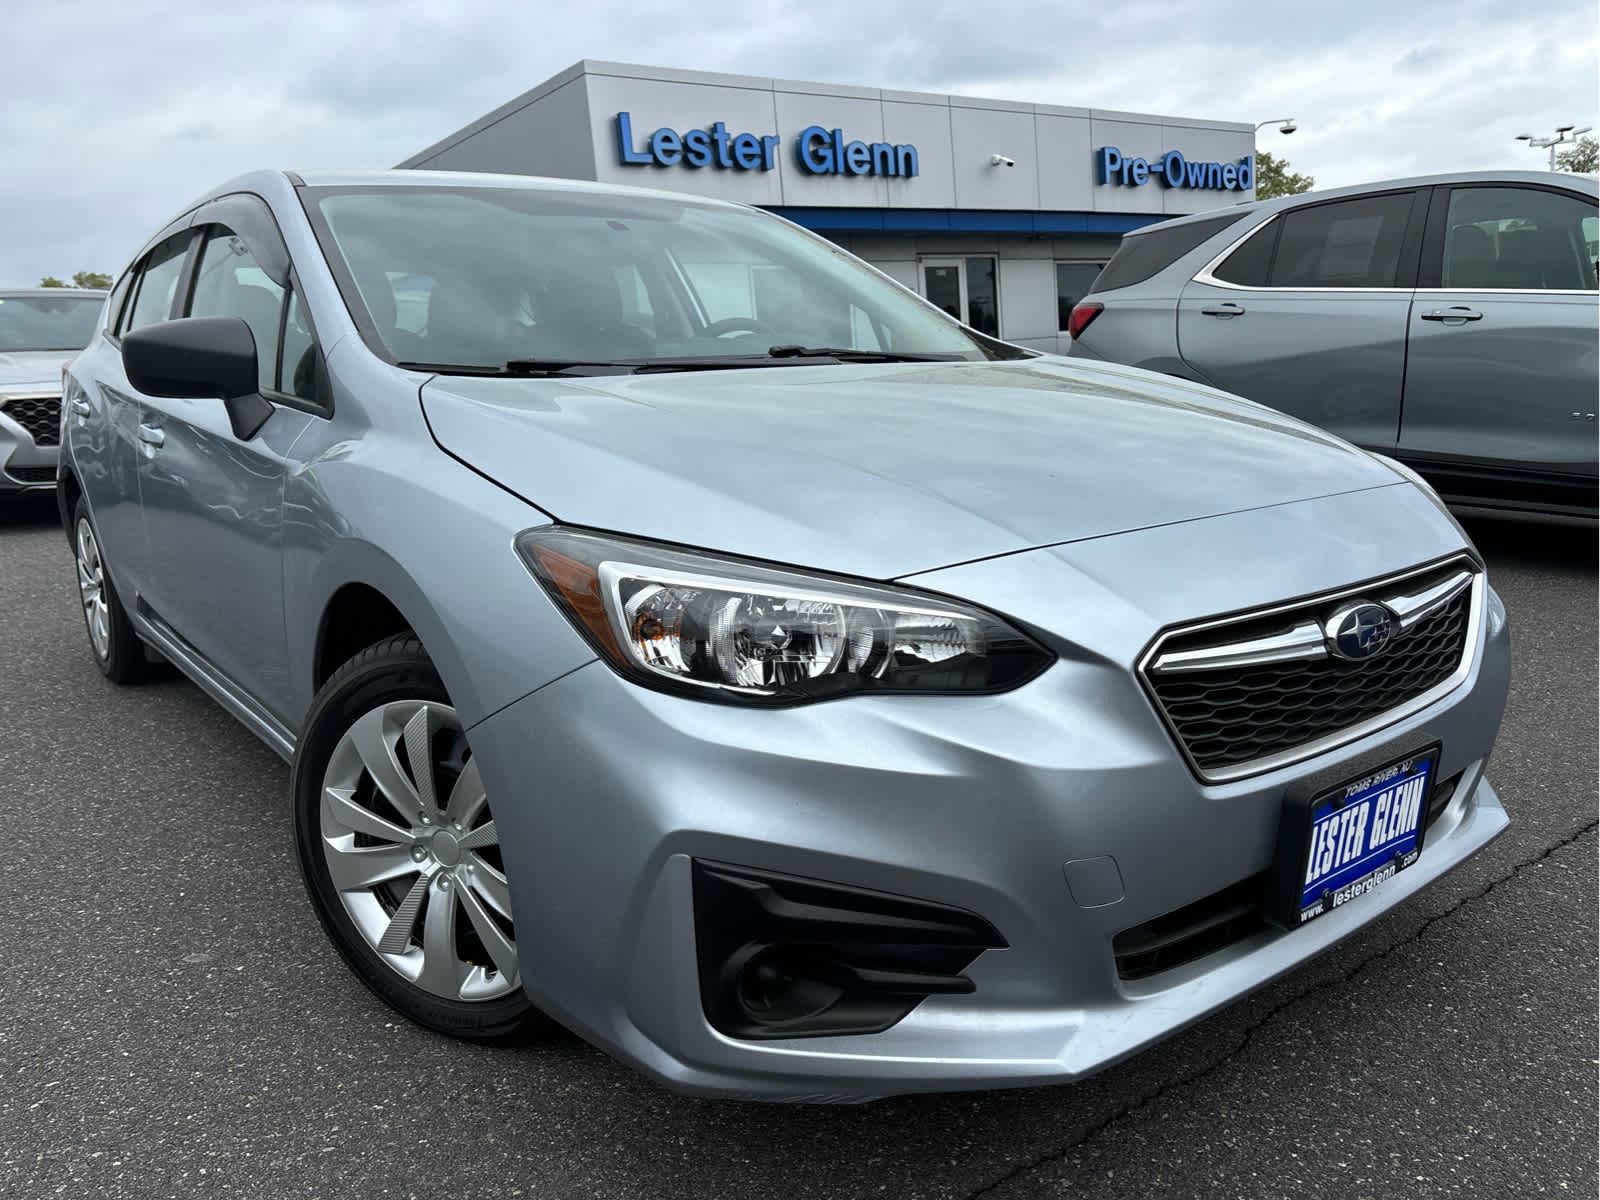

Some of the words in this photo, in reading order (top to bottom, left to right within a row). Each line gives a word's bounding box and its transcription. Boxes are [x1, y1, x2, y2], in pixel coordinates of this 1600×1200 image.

[615, 111, 780, 171] Lester
[798, 125, 919, 178] Glenn
[1098, 146, 1253, 190] Pre-Owned
[1344, 777, 1372, 798] TOMS
[1304, 801, 1370, 886] LESTER
[1369, 776, 1425, 850] GLENN
[1332, 864, 1396, 908] lesterglenn
